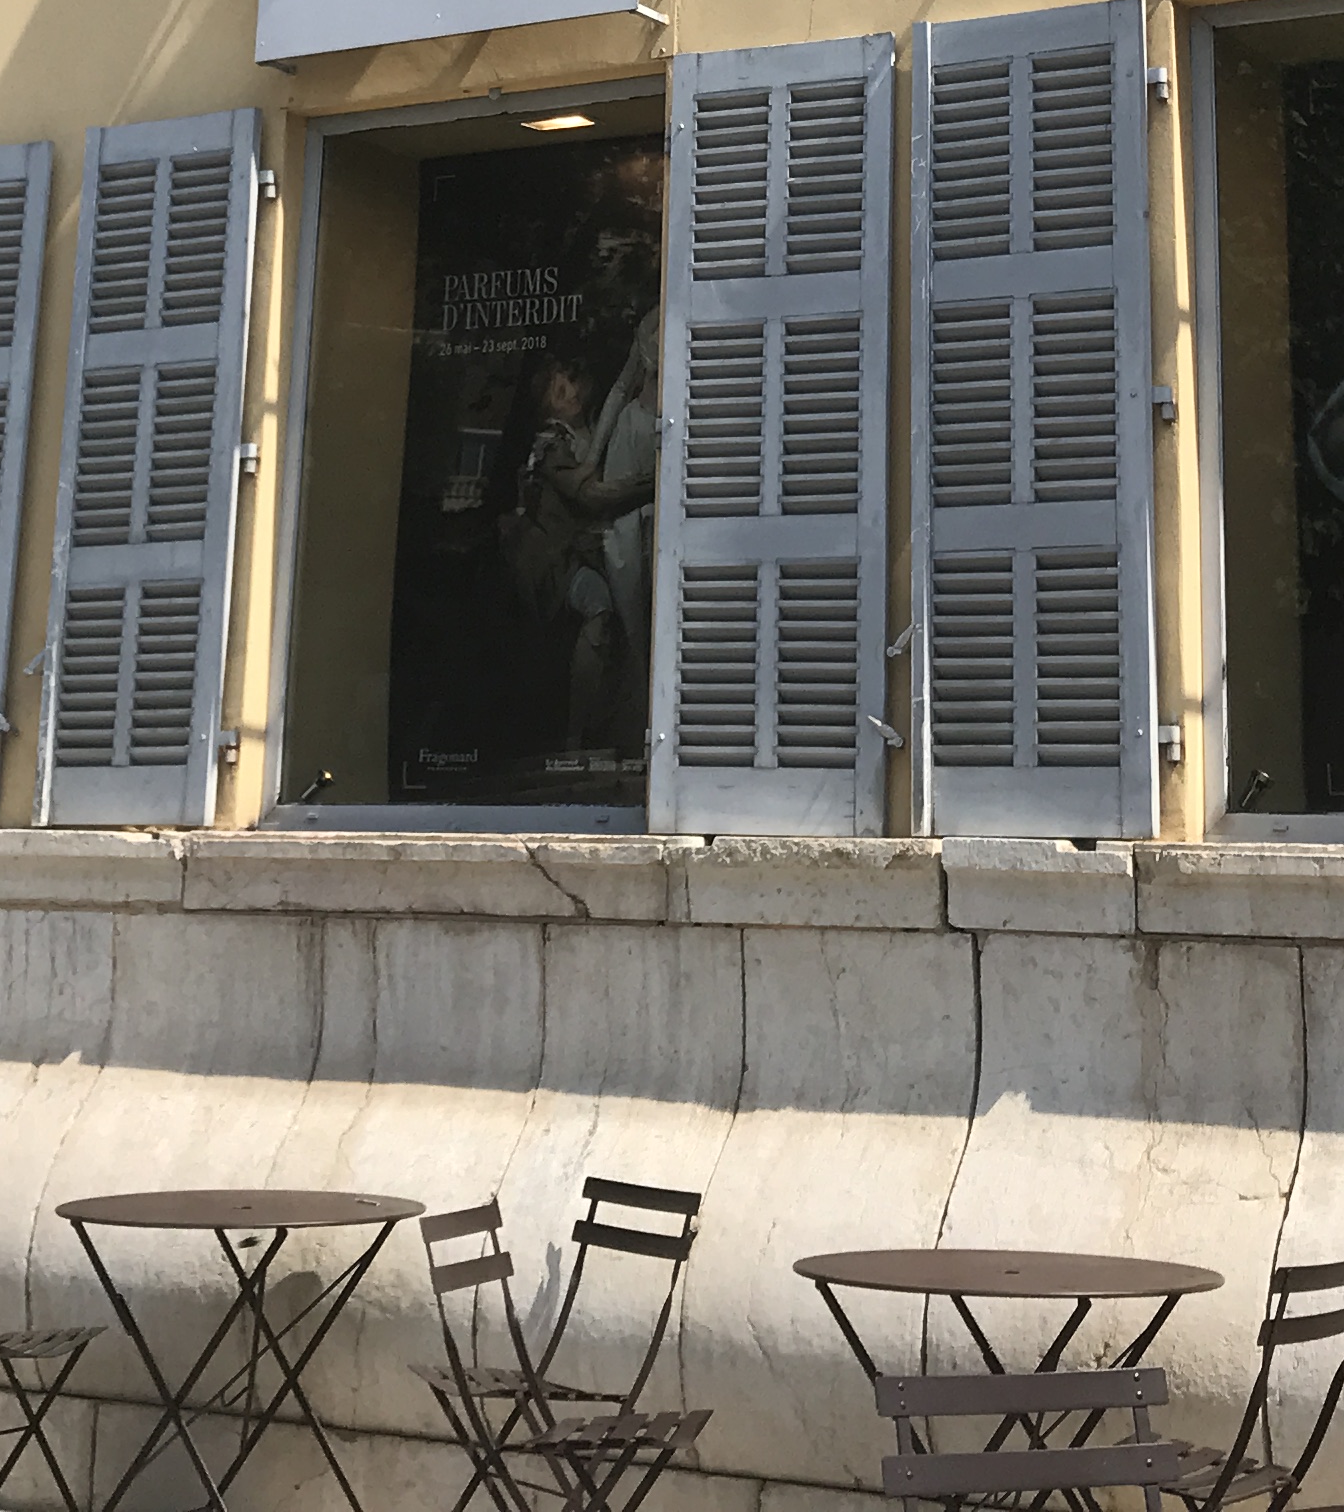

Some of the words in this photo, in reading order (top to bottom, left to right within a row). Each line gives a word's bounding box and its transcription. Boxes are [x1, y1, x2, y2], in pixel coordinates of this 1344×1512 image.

[444, 266, 559, 303] PARFUMS
[442, 294, 583, 332] D'INTERDIT
[481, 339, 495, 354] 23
[521, 335, 548, 351] 2018
